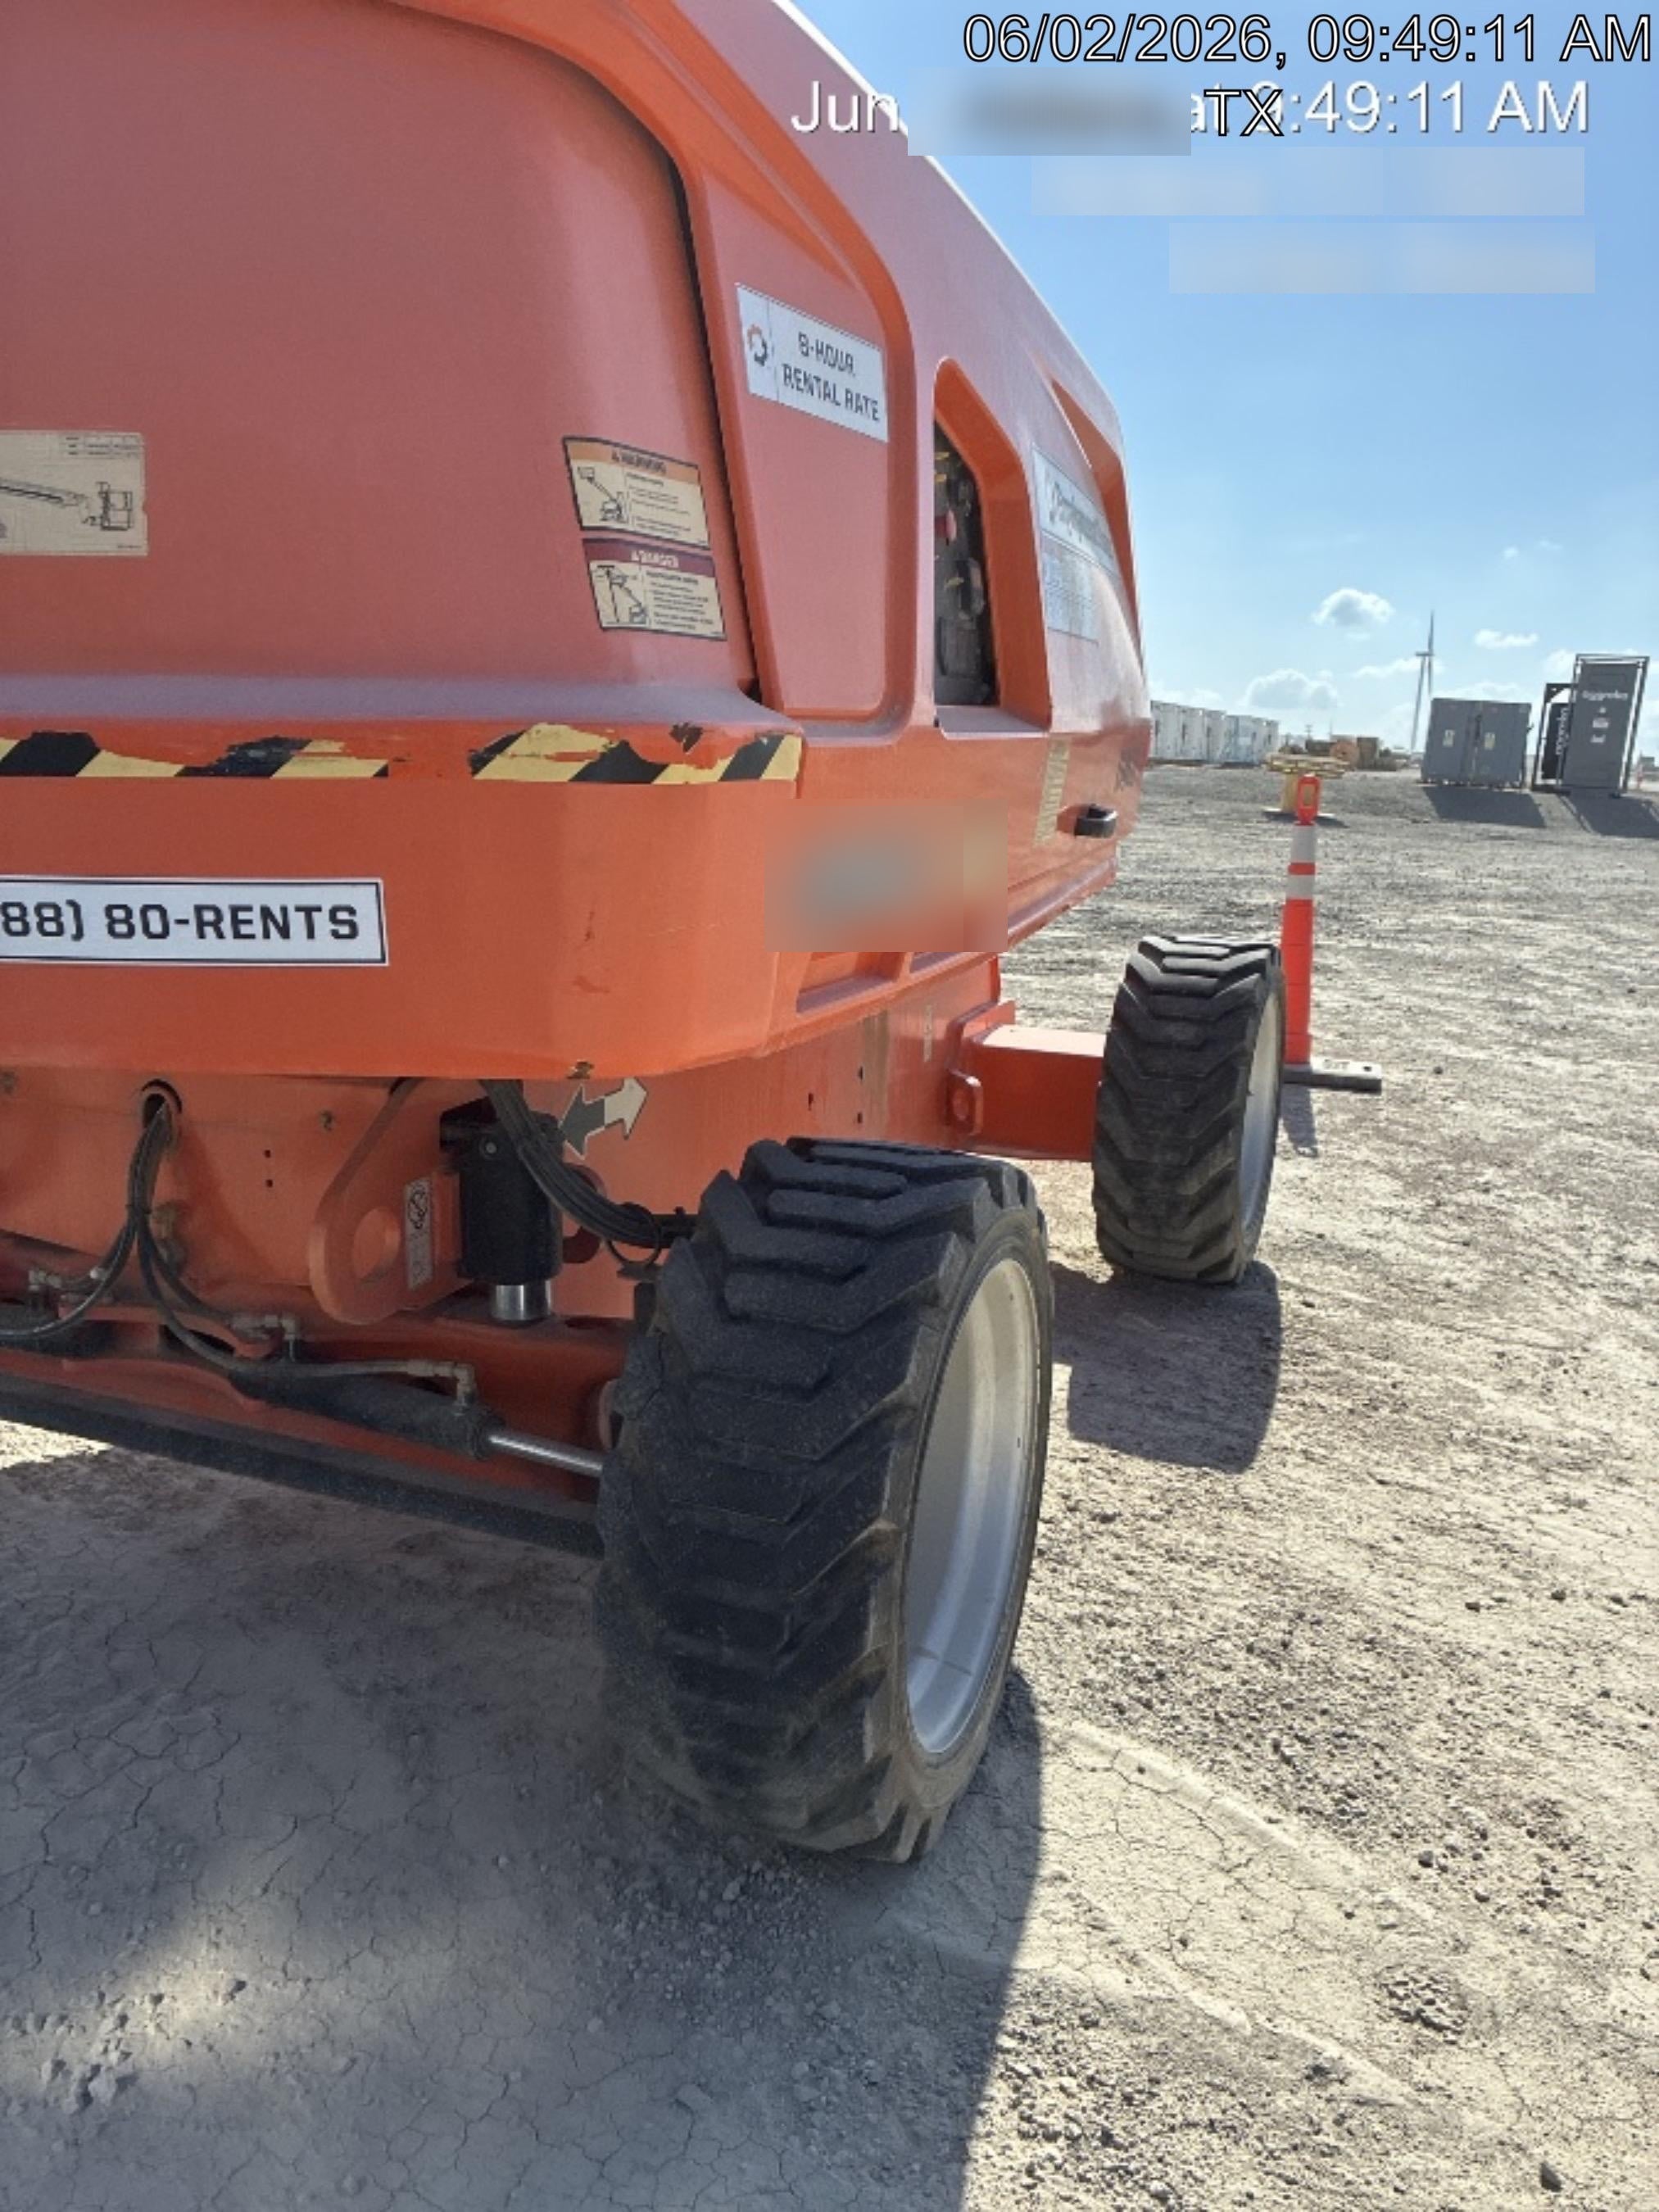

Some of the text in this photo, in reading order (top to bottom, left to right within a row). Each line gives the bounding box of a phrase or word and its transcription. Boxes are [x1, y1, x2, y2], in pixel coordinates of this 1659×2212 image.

[782, 363, 880, 422] RENTAL RATE
[0, 900, 360, 942] 88) 80-RENTS
